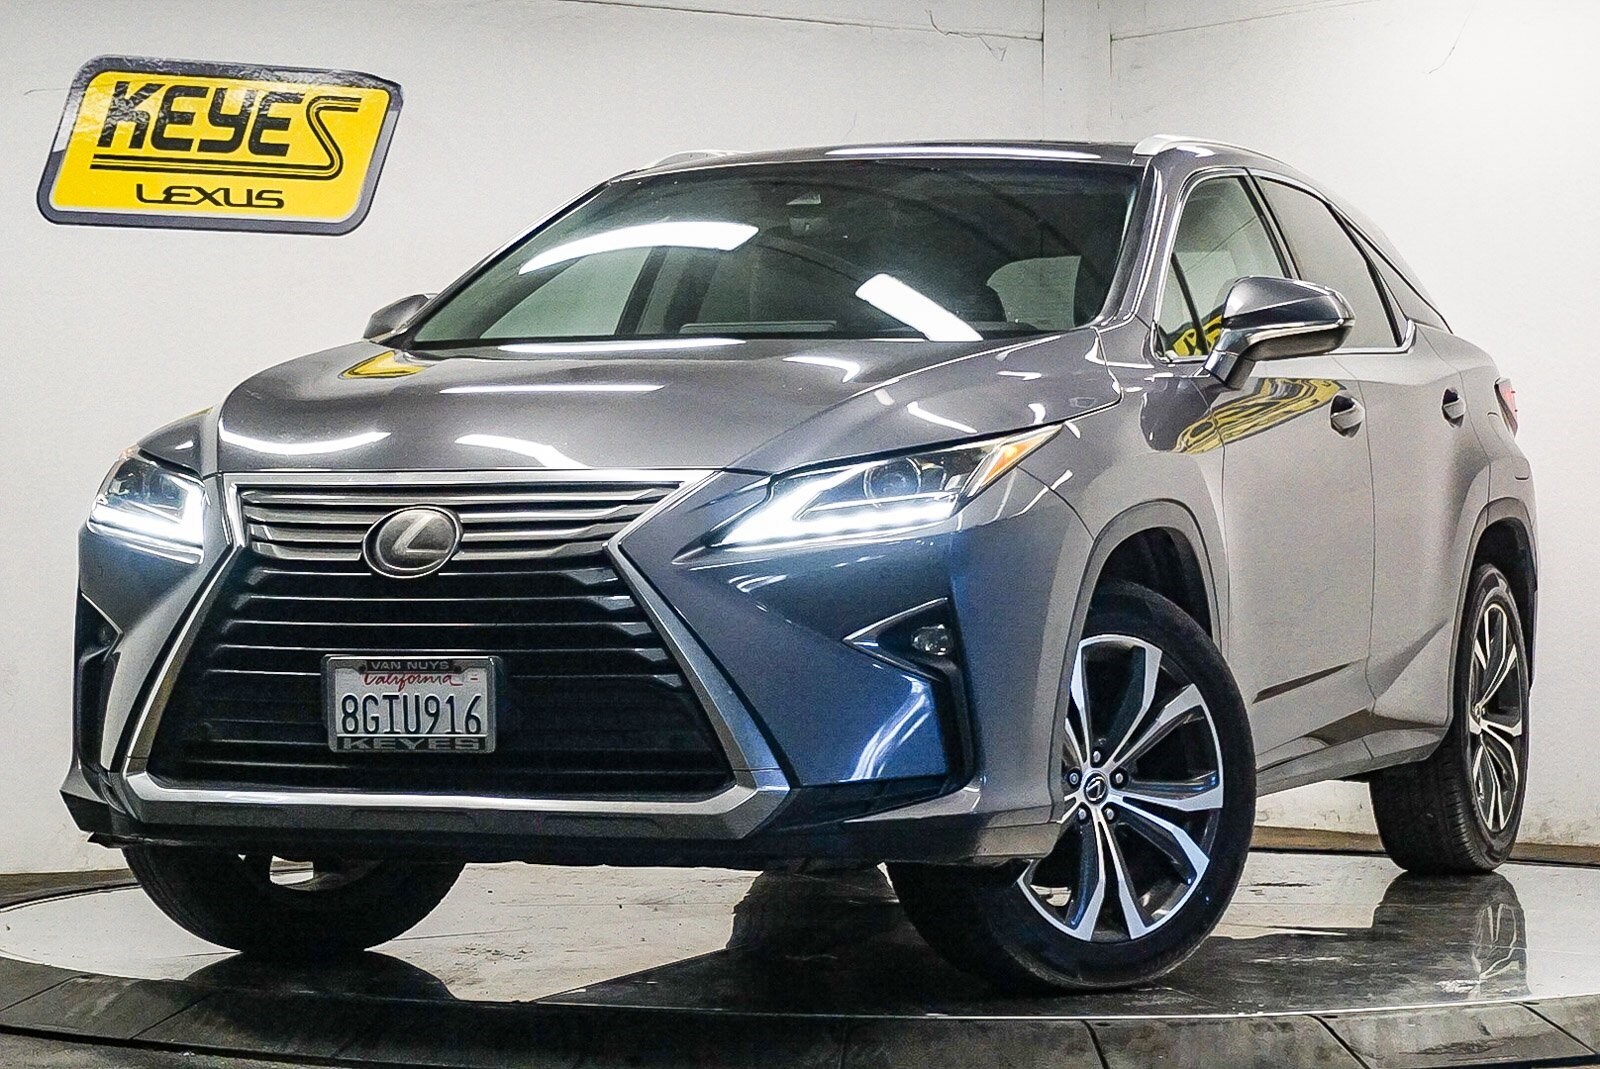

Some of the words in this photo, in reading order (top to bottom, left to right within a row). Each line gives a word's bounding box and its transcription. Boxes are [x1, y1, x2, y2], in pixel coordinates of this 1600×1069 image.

[92, 80, 362, 181] KEYES
[135, 183, 285, 209] LEXUS
[370, 660, 401, 670] VAN
[406, 660, 450, 670] NUYS
[364, 672, 464, 692] California
[343, 737, 481, 750] KEYES
